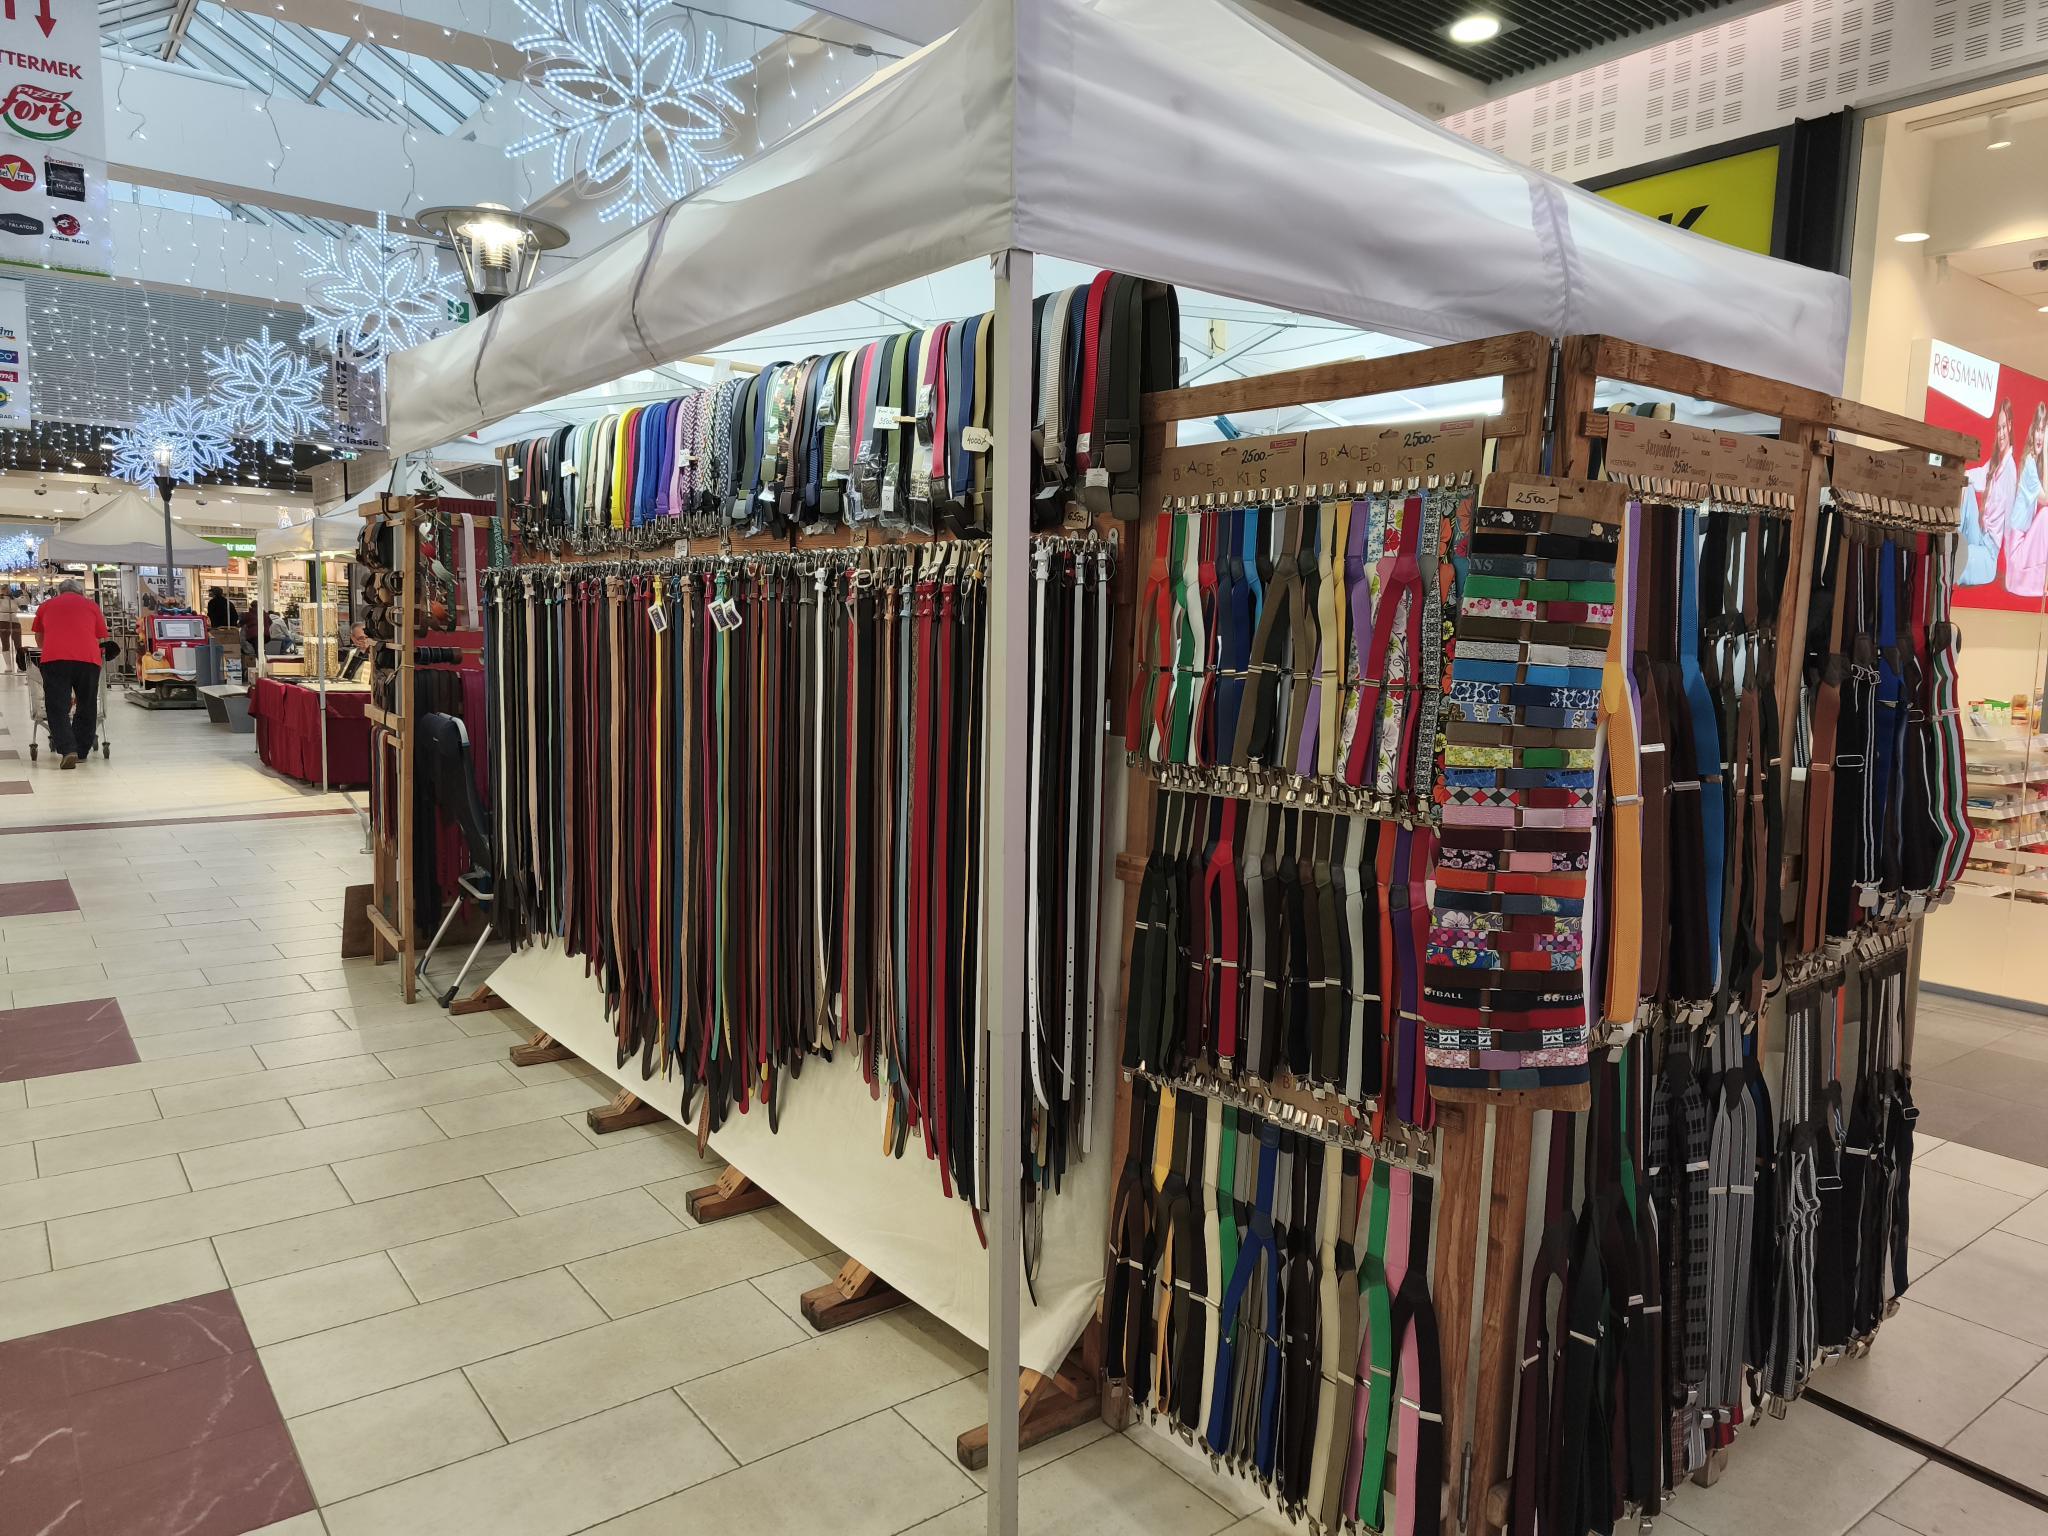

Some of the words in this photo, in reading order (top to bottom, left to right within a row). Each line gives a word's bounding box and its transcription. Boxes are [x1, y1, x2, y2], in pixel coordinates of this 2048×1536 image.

[17, 86, 64, 101] PIZZA
[1933, 353, 1994, 393] ROSSMANN
[338, 435, 379, 447] Classic
